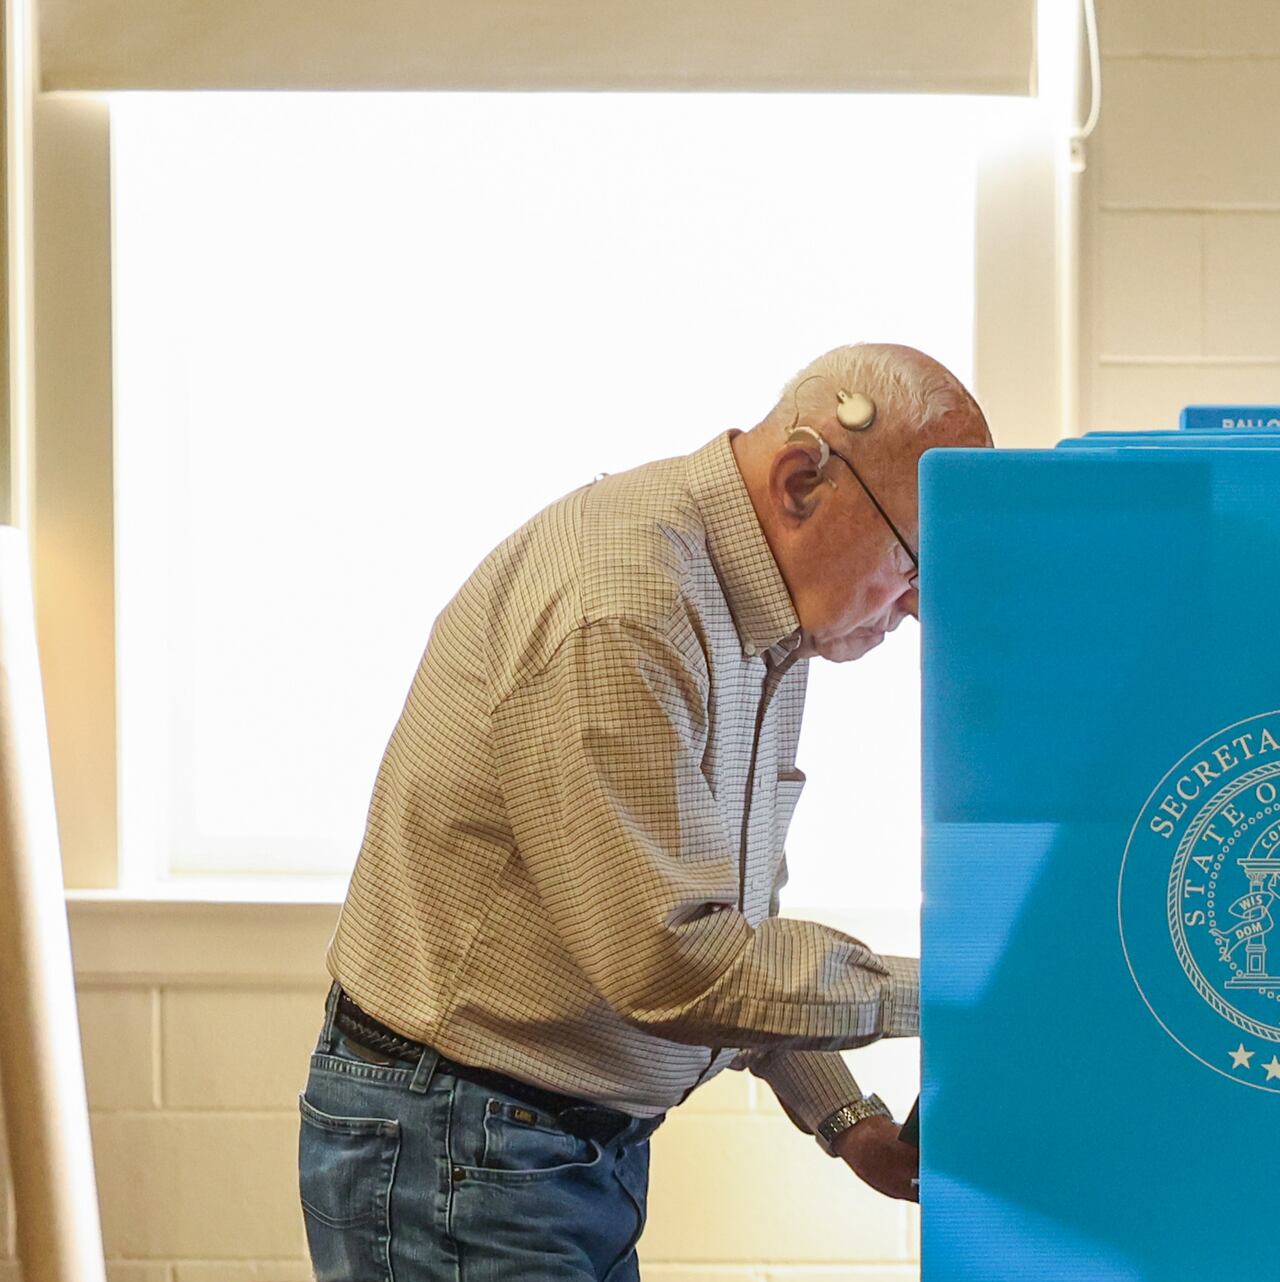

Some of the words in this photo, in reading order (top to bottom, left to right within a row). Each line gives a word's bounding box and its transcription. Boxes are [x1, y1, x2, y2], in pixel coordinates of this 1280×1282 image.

[1185, 803, 1245, 926] STATE
[1239, 894, 1263, 911] WIS
[1235, 921, 1262, 939] DOM
